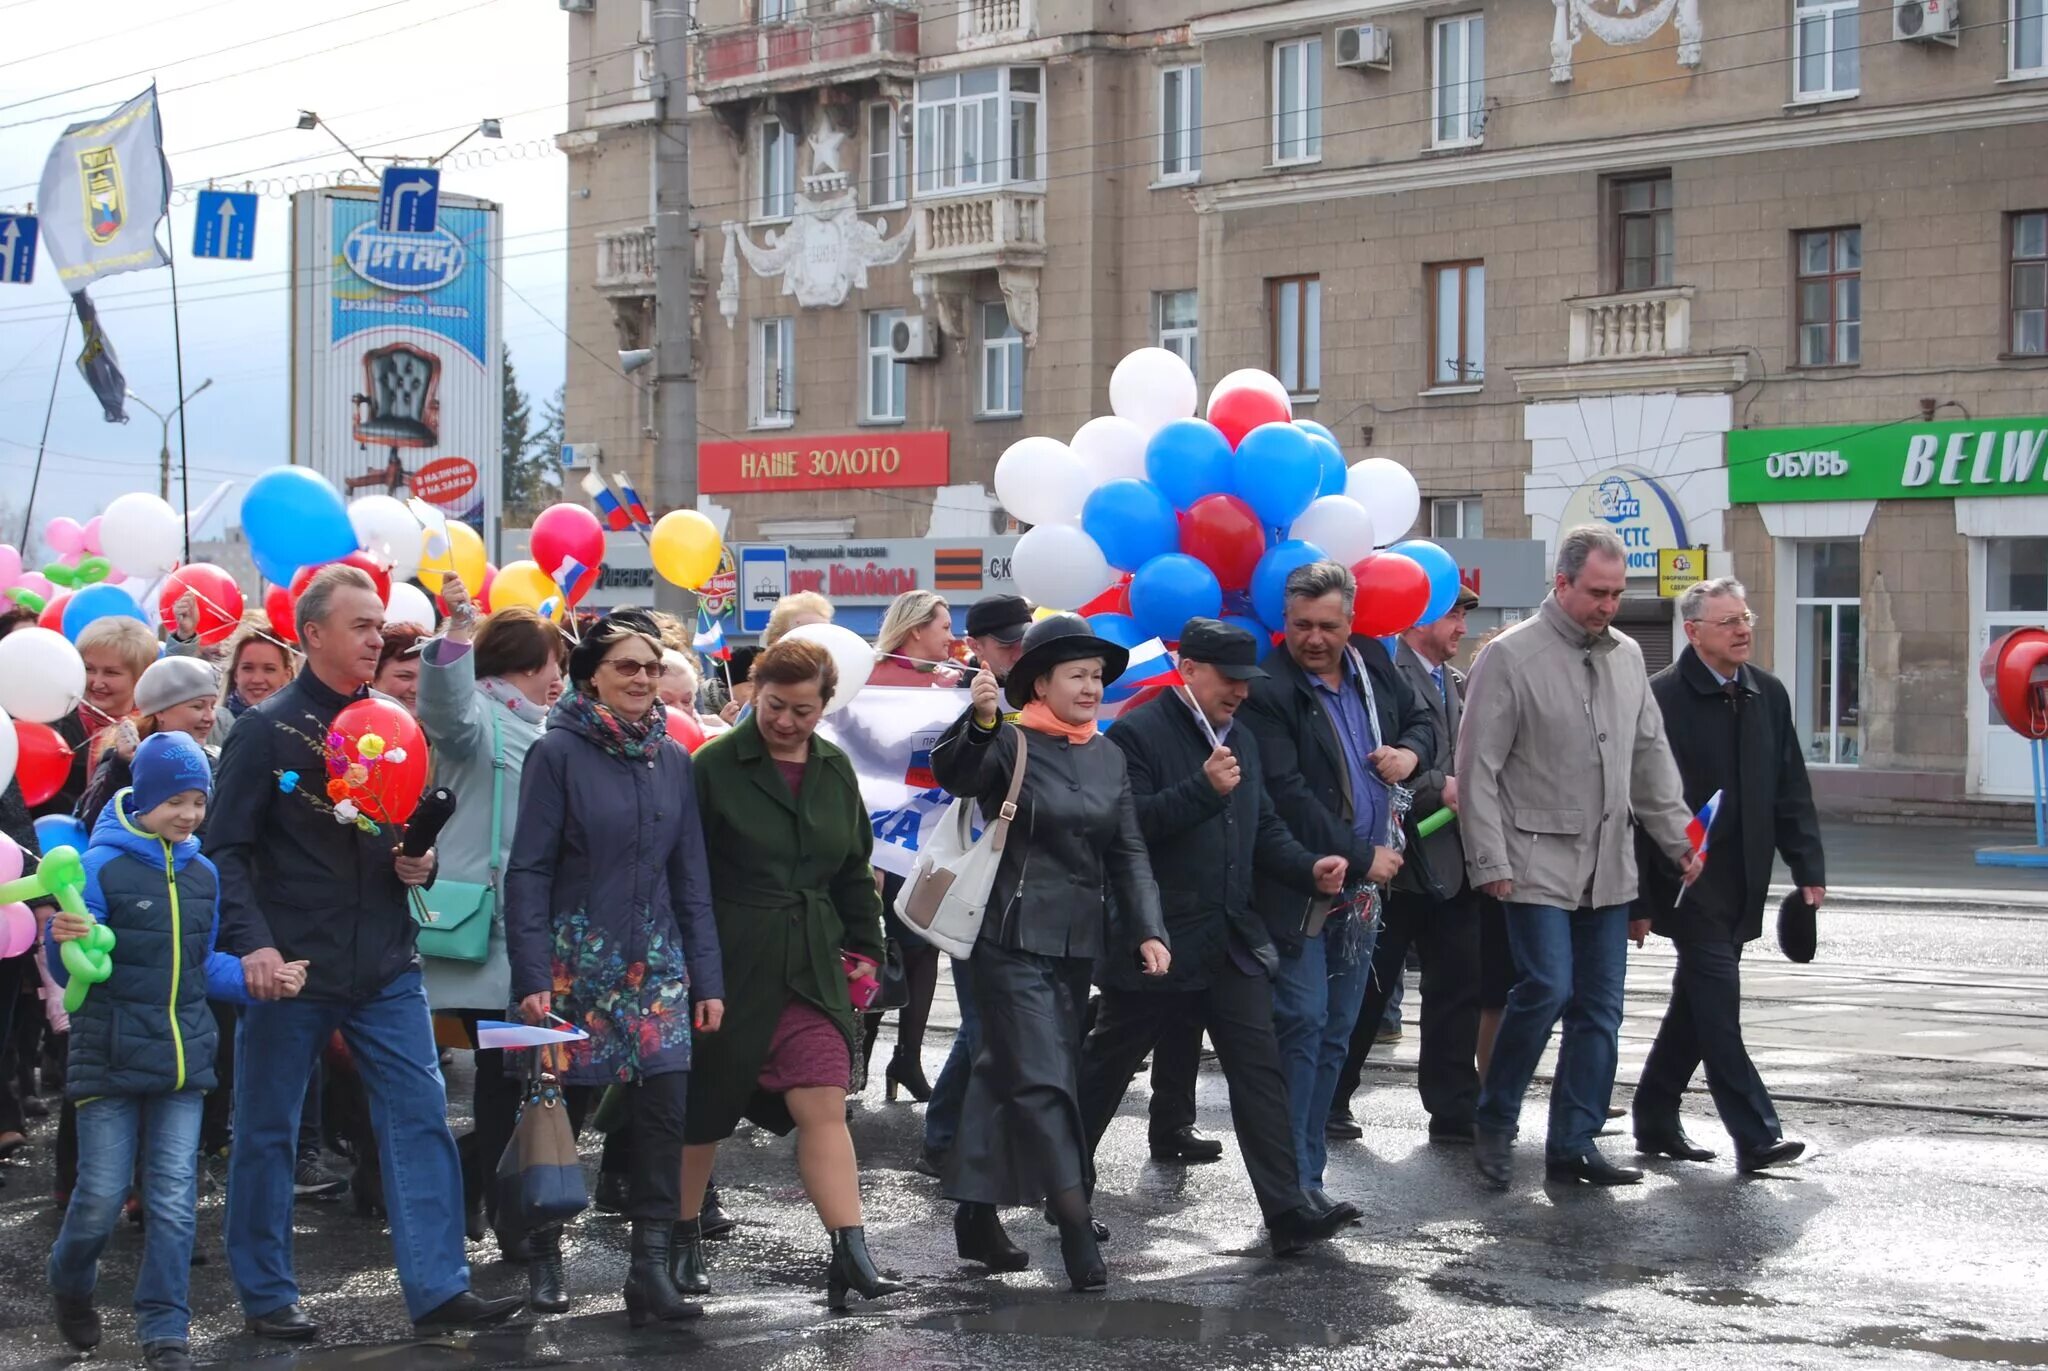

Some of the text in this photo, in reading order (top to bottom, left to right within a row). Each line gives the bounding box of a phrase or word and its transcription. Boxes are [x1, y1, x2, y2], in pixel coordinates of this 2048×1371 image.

[741, 446, 900, 479] НАШЕ ЗОЛОТО
[1765, 450, 1848, 479] ОБУВЬ
[1901, 428, 2048, 487] BELW
